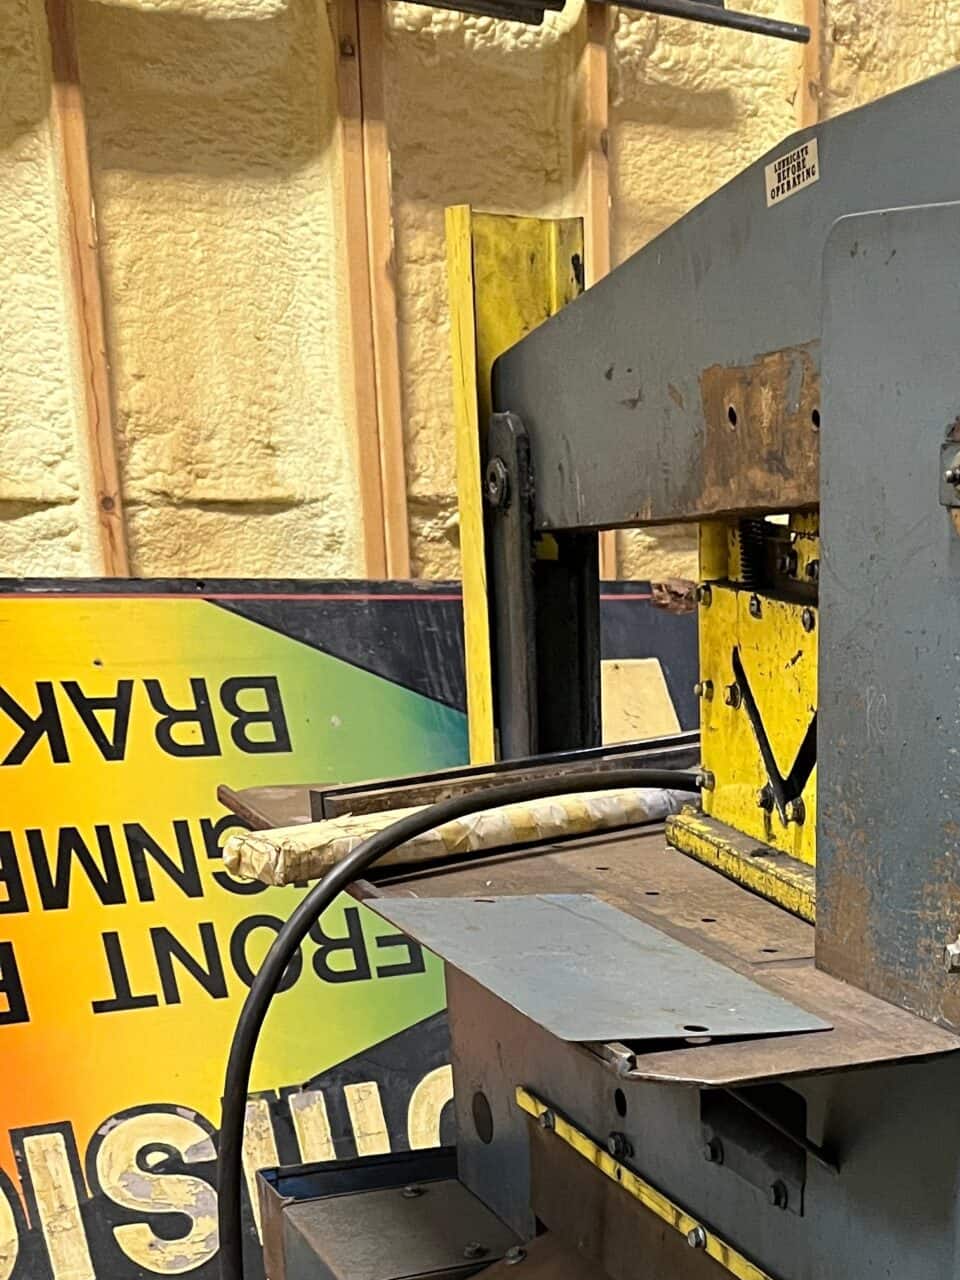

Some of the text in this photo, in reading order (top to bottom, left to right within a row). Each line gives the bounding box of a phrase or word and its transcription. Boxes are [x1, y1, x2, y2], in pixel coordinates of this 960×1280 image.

[774, 146, 809, 173] LUBRICATE
[777, 158, 807, 184] BEFORE
[771, 164, 816, 200] OPERATING
[92, 907, 426, 1015] FRONT
